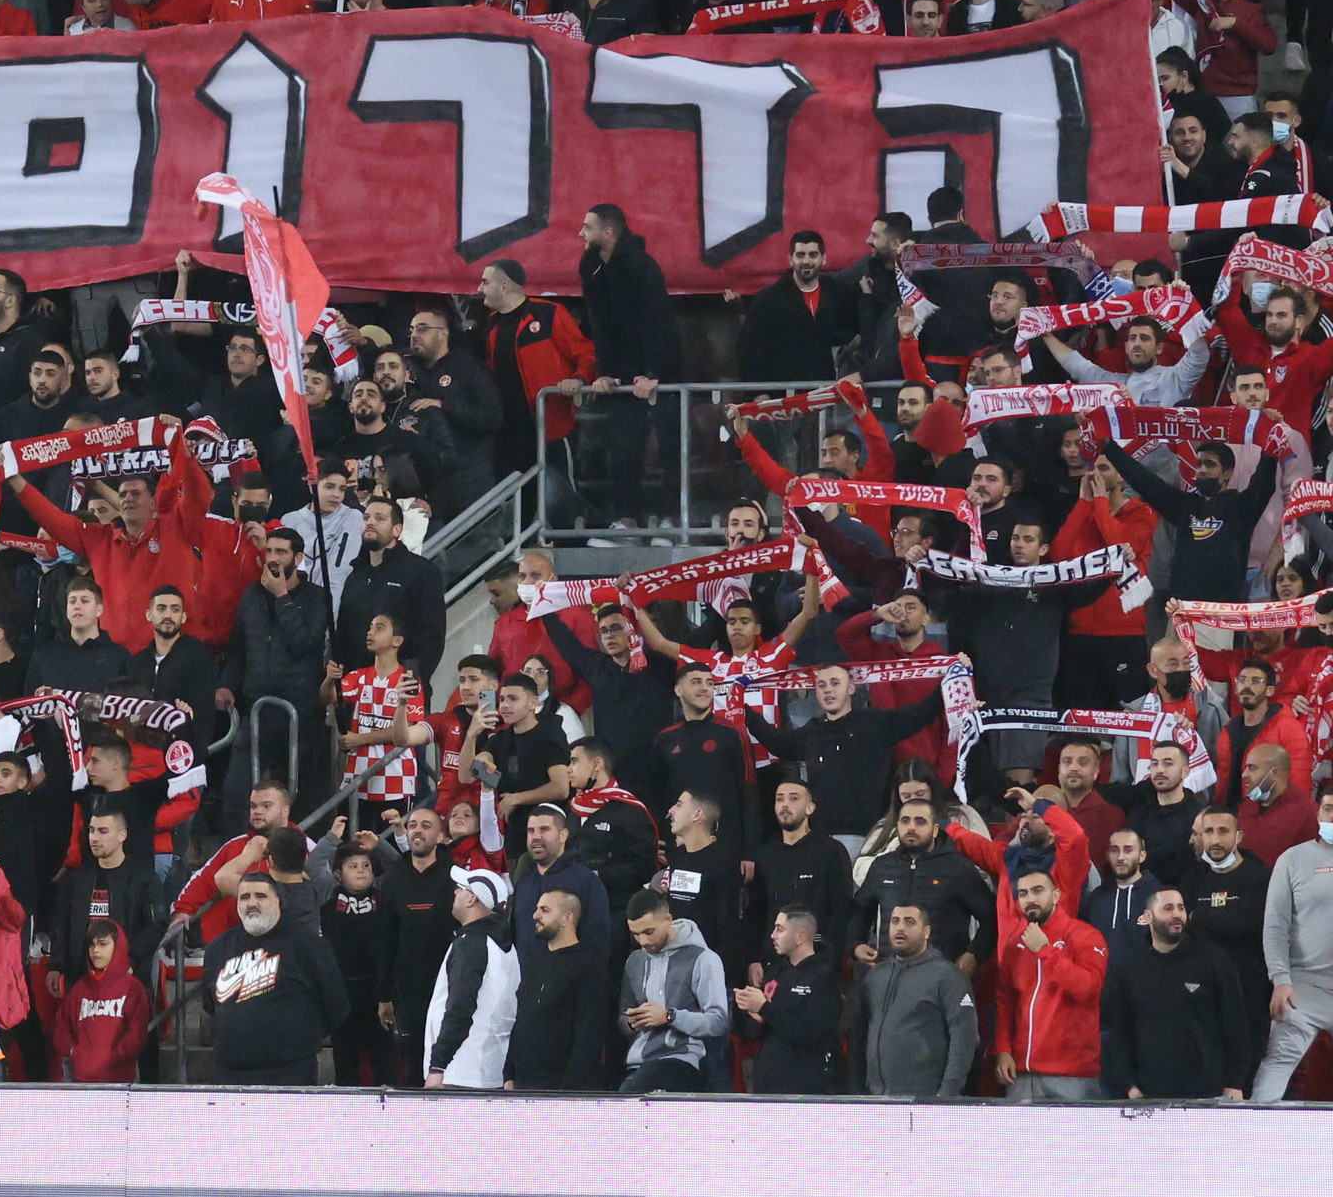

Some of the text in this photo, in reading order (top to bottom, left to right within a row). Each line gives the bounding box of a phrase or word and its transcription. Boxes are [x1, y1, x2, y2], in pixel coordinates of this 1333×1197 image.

[1262, 242, 1295, 267] באר
[1137, 422, 1226, 442] באר שבע
[800, 482, 947, 505] הפועל באר שבע
[646, 556, 771, 594] גאוות הנגב
[78, 995, 127, 1021] ROCKY
